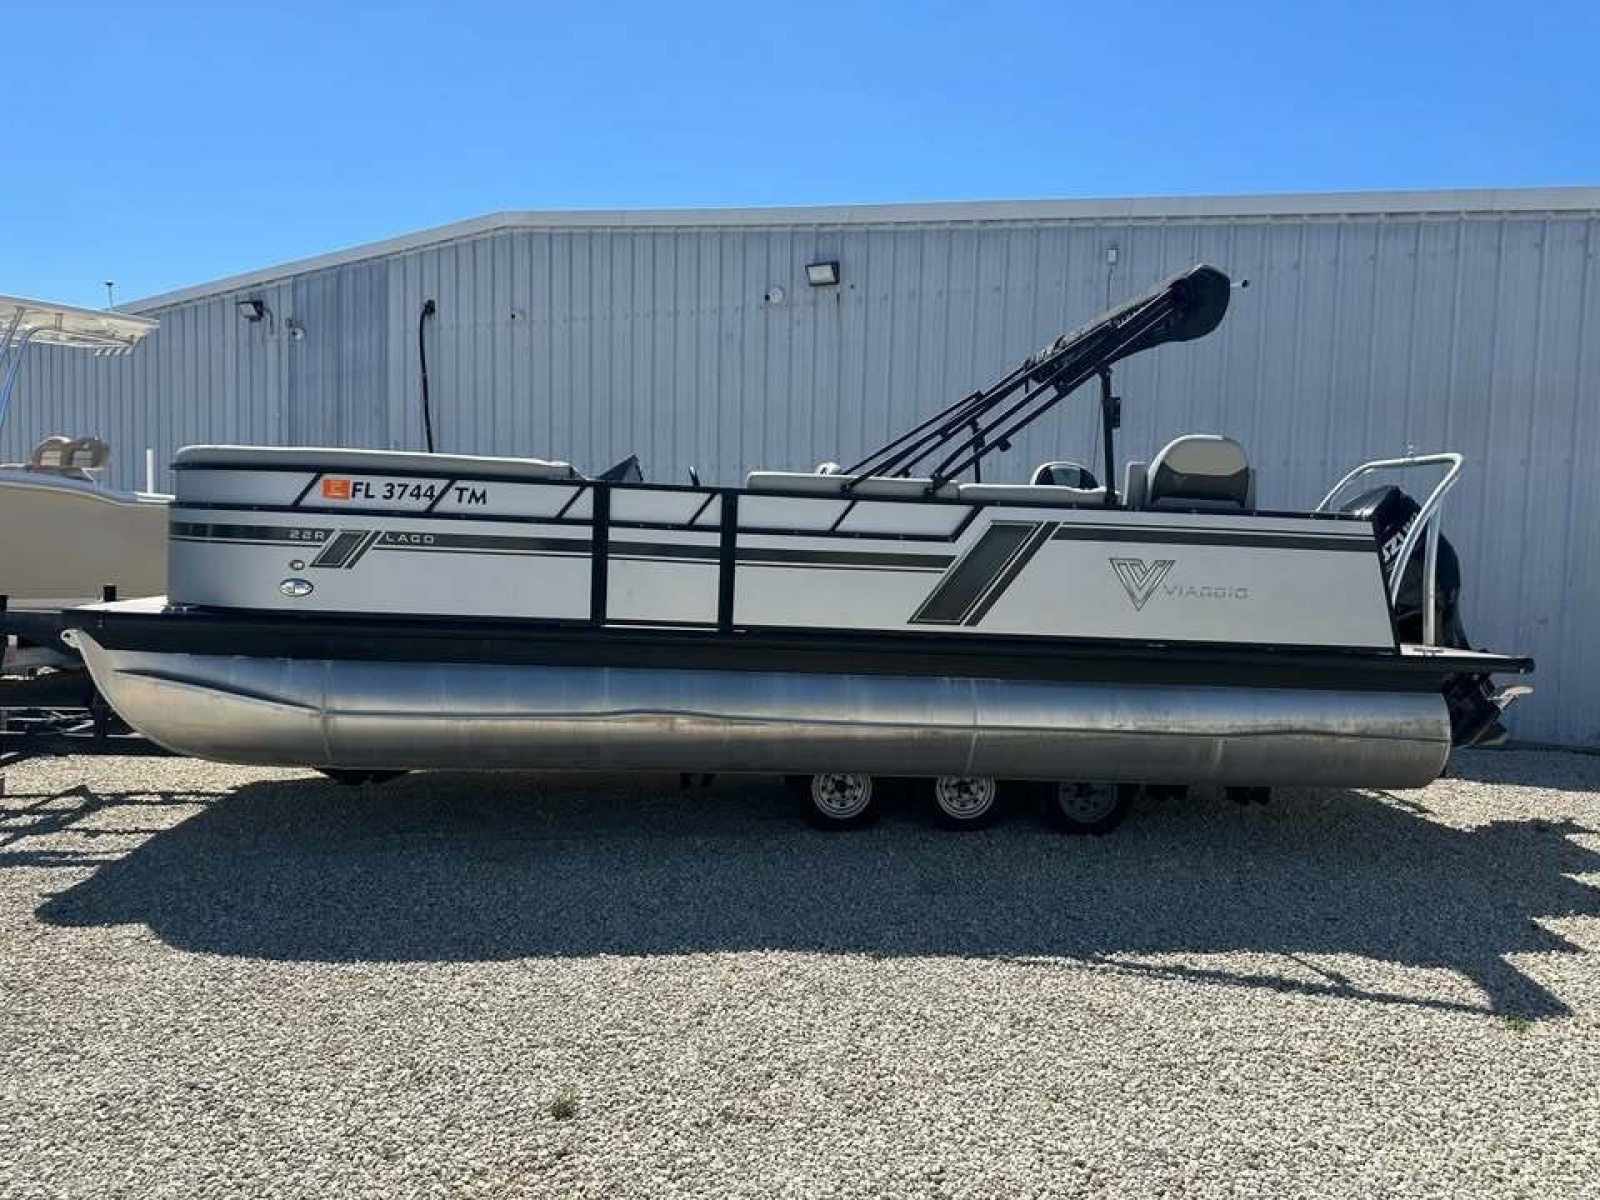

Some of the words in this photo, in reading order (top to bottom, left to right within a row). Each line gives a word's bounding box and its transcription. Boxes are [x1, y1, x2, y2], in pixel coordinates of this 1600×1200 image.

[351, 481, 376, 499] FL
[382, 482, 436, 501] 3744
[454, 486, 488, 505] TM
[386, 532, 435, 544] LAGO
